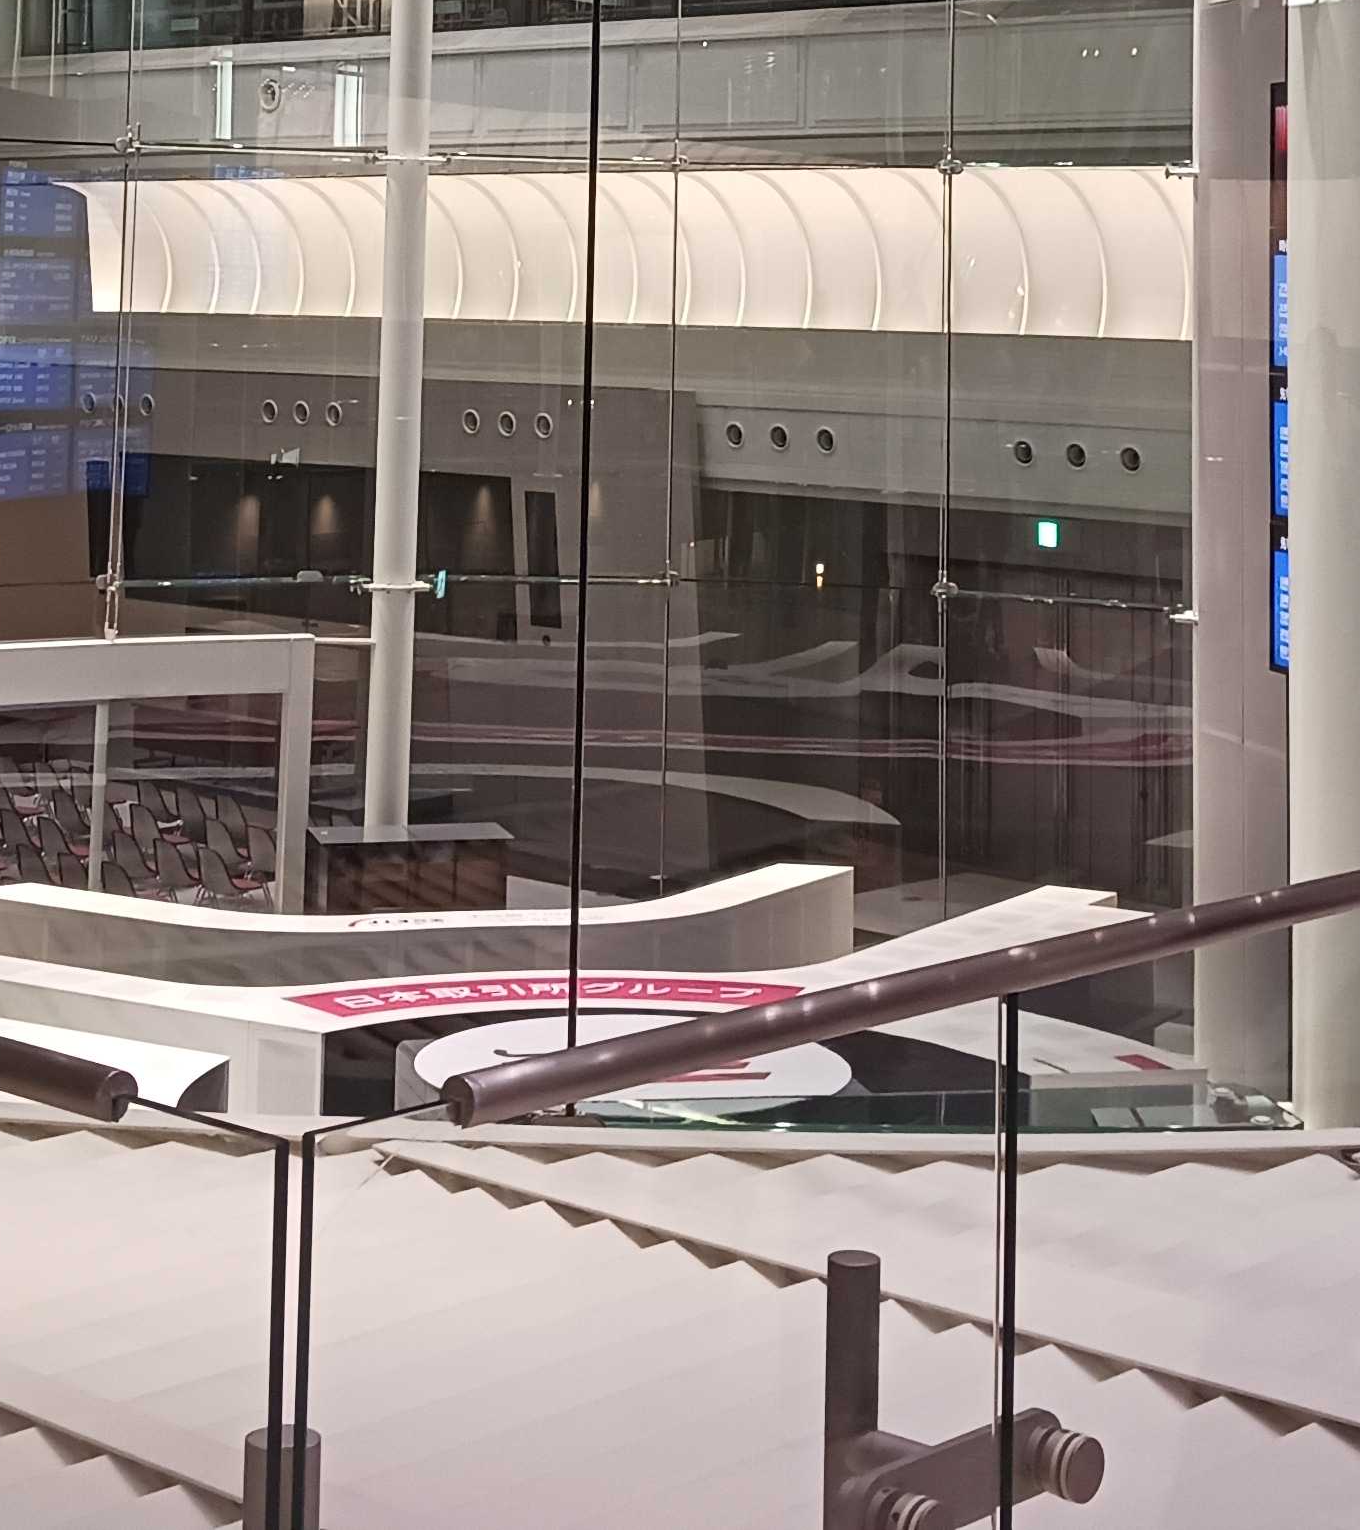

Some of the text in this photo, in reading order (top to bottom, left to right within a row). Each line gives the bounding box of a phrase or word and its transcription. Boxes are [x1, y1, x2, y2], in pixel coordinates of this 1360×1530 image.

[334, 980, 763, 1010] 日本取引所グループ
